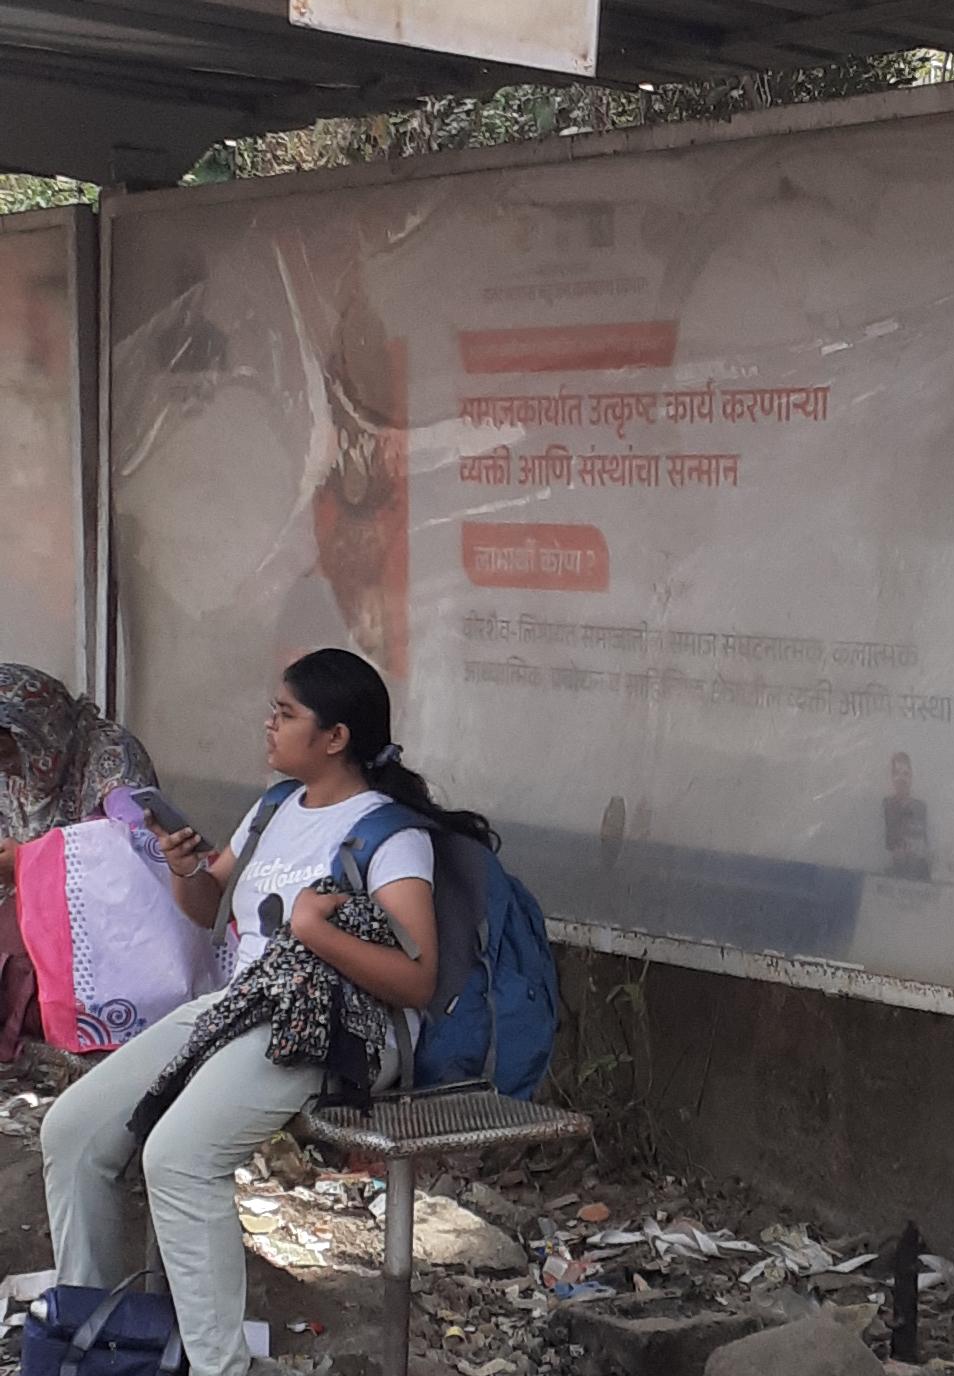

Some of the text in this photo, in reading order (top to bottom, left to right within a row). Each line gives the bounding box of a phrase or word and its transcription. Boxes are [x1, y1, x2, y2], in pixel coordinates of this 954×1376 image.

[588, 392, 660, 439] उत्कृष्ट
[663, 377, 715, 423] कार्य
[459, 444, 741, 488] व्यक्ती आणि संस्थांचा सन्मान
